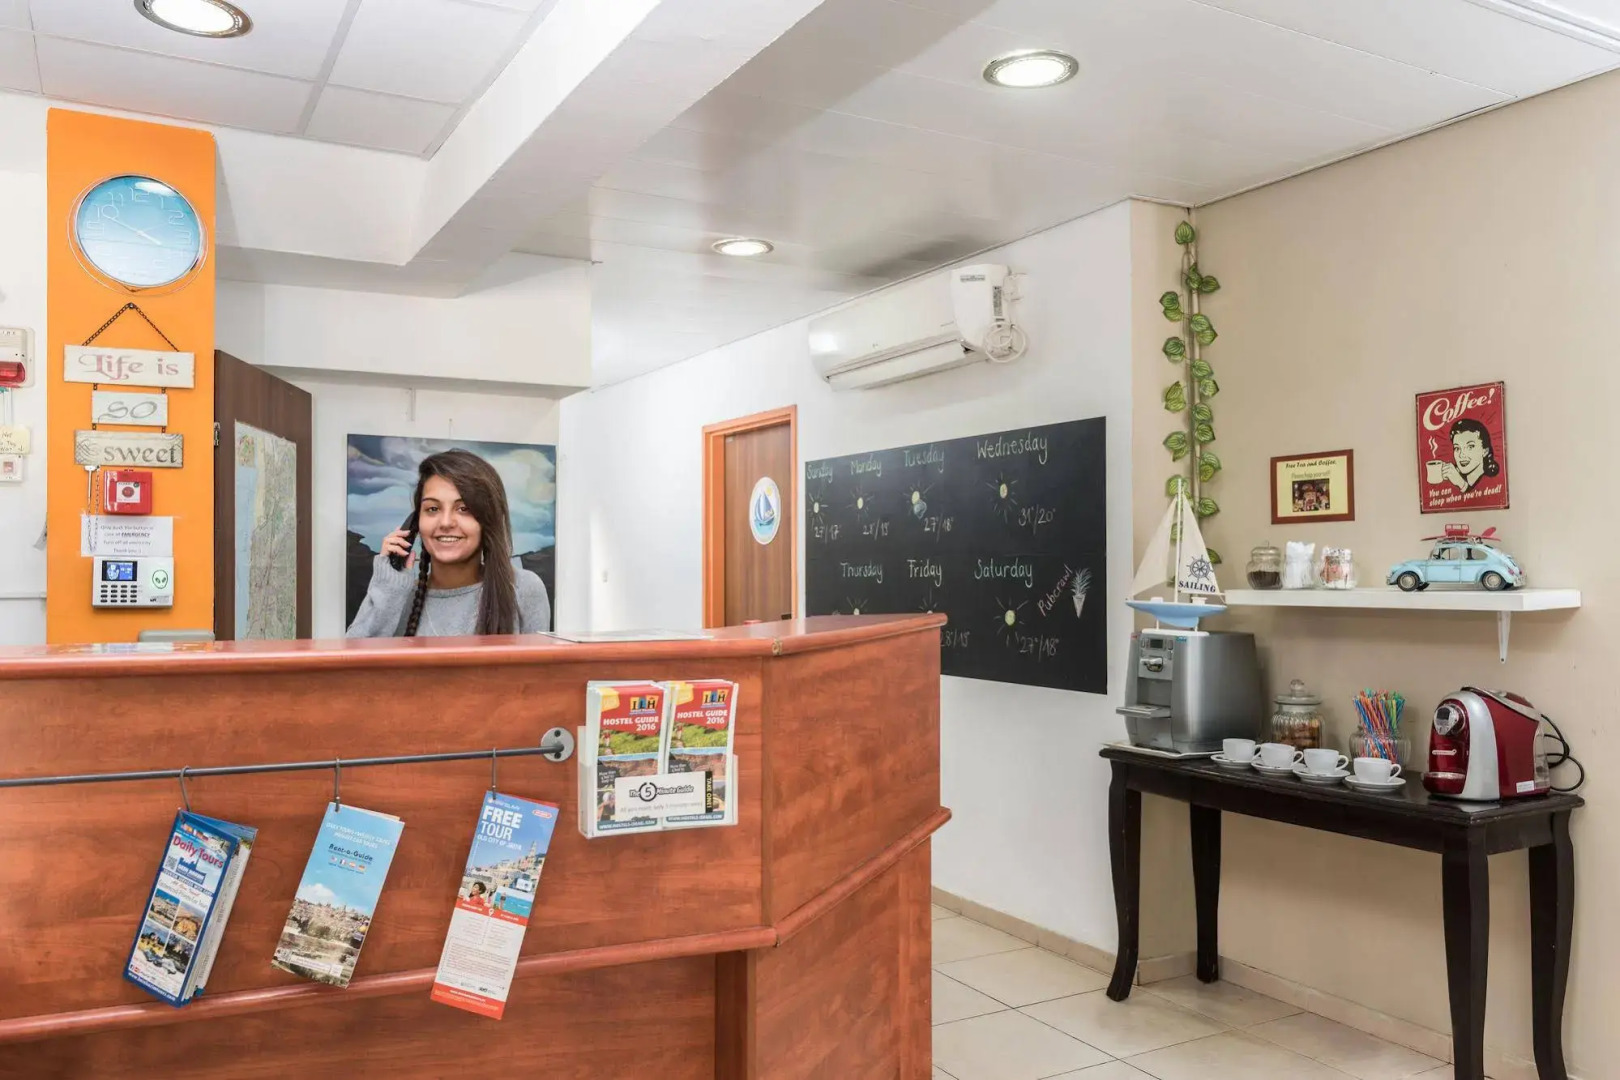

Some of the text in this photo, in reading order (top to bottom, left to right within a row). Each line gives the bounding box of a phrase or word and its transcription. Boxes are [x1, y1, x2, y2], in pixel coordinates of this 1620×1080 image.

[78, 353, 180, 381] Life is
[1423, 388, 1495, 431] Coffee!
[104, 446, 178, 465] sweet
[903, 444, 945, 474] Tuesday
[977, 431, 1048, 465] Wednesday
[807, 463, 833, 484] Sunday
[850, 453, 882, 477] Monday
[1429, 487, 1452, 498] You can
[1429, 497, 1445, 507] sleep
[1446, 494, 1462, 505] when
[840, 561, 883, 584] Thursday
[907, 559, 942, 587] Friday
[974, 558, 1033, 588] Saturday
[1178, 580, 1216, 593] SAILING
[603, 716, 659, 726] HOSTEL GUIDE
[677, 709, 728, 719] HOSTEL GUIDE
[706, 717, 725, 725] 2016
[636, 723, 656, 731] 2016
[482, 805, 523, 829] FREE
[481, 820, 513, 841] TOUR
[172, 834, 196, 858] Daily
[197, 846, 224, 869] Tours
